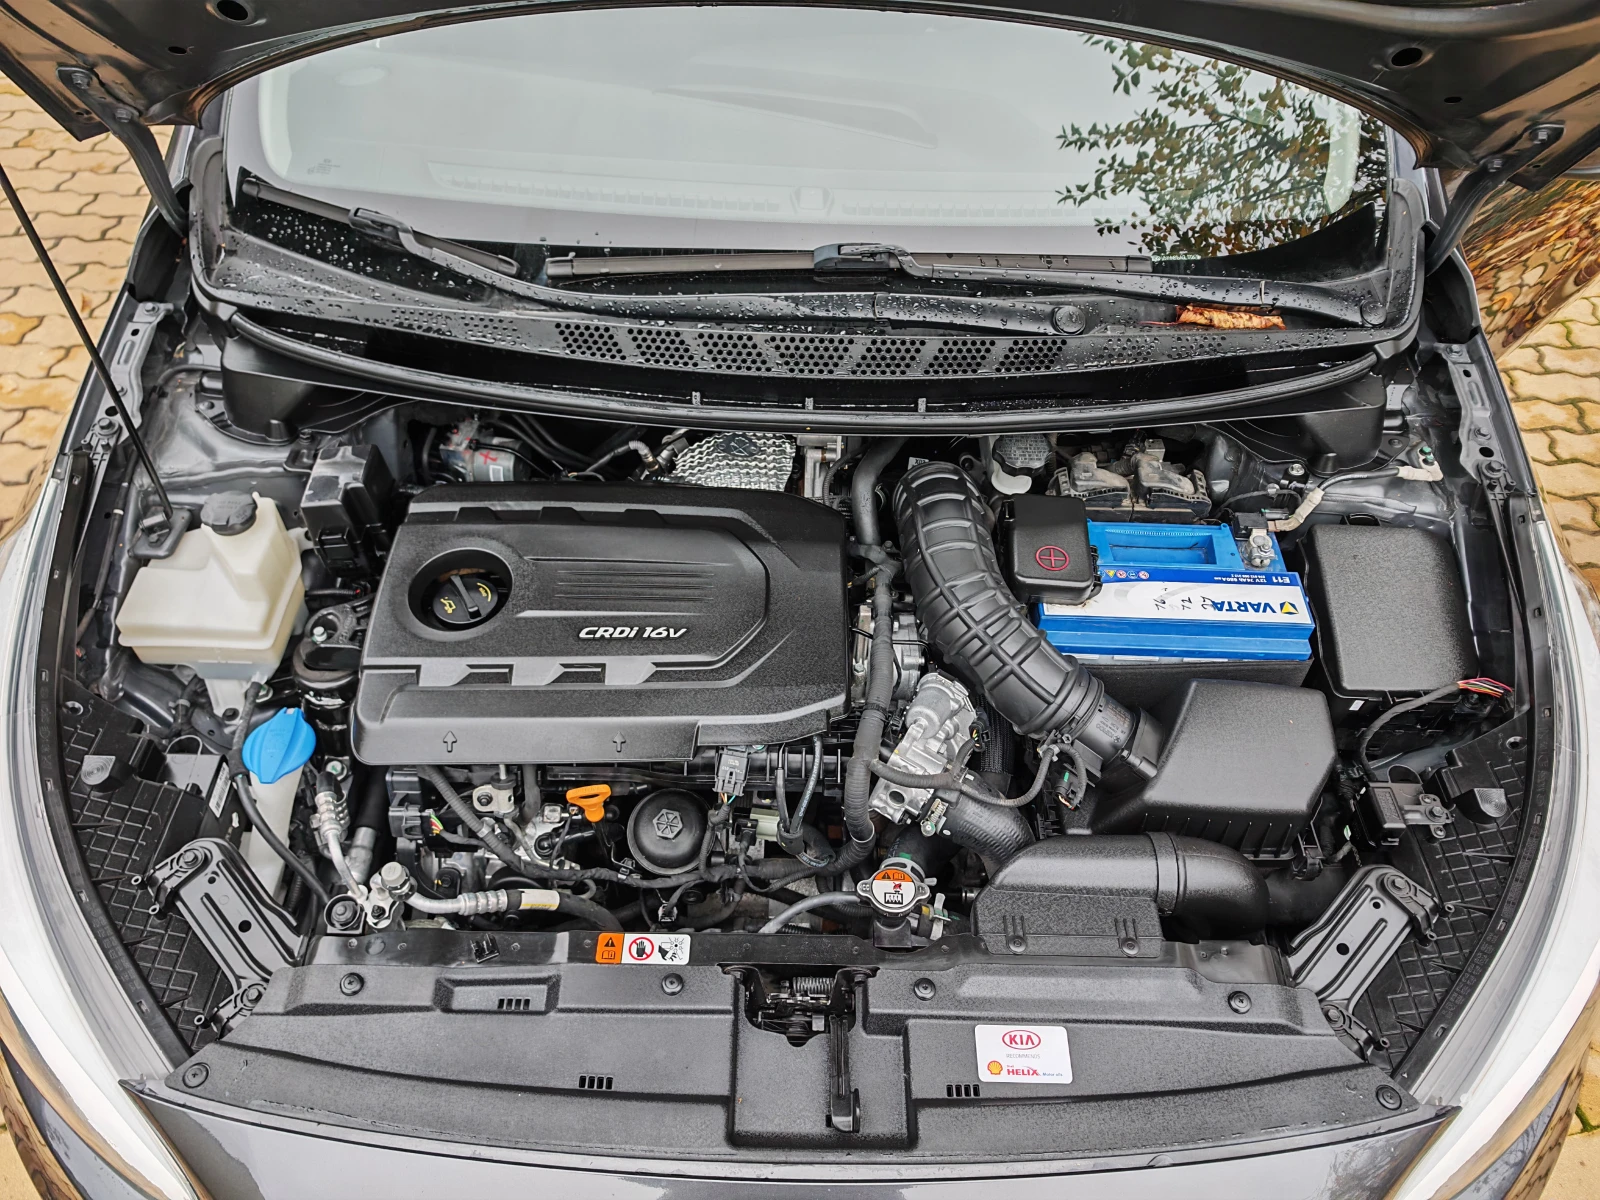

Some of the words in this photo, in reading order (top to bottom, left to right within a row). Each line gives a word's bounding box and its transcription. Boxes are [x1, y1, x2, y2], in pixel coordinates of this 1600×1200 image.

[1211, 600, 1277, 613] VARTA
[579, 627, 639, 637] CRDi
[642, 627, 687, 637] 16V
[1009, 1034, 1035, 1045] KIA
